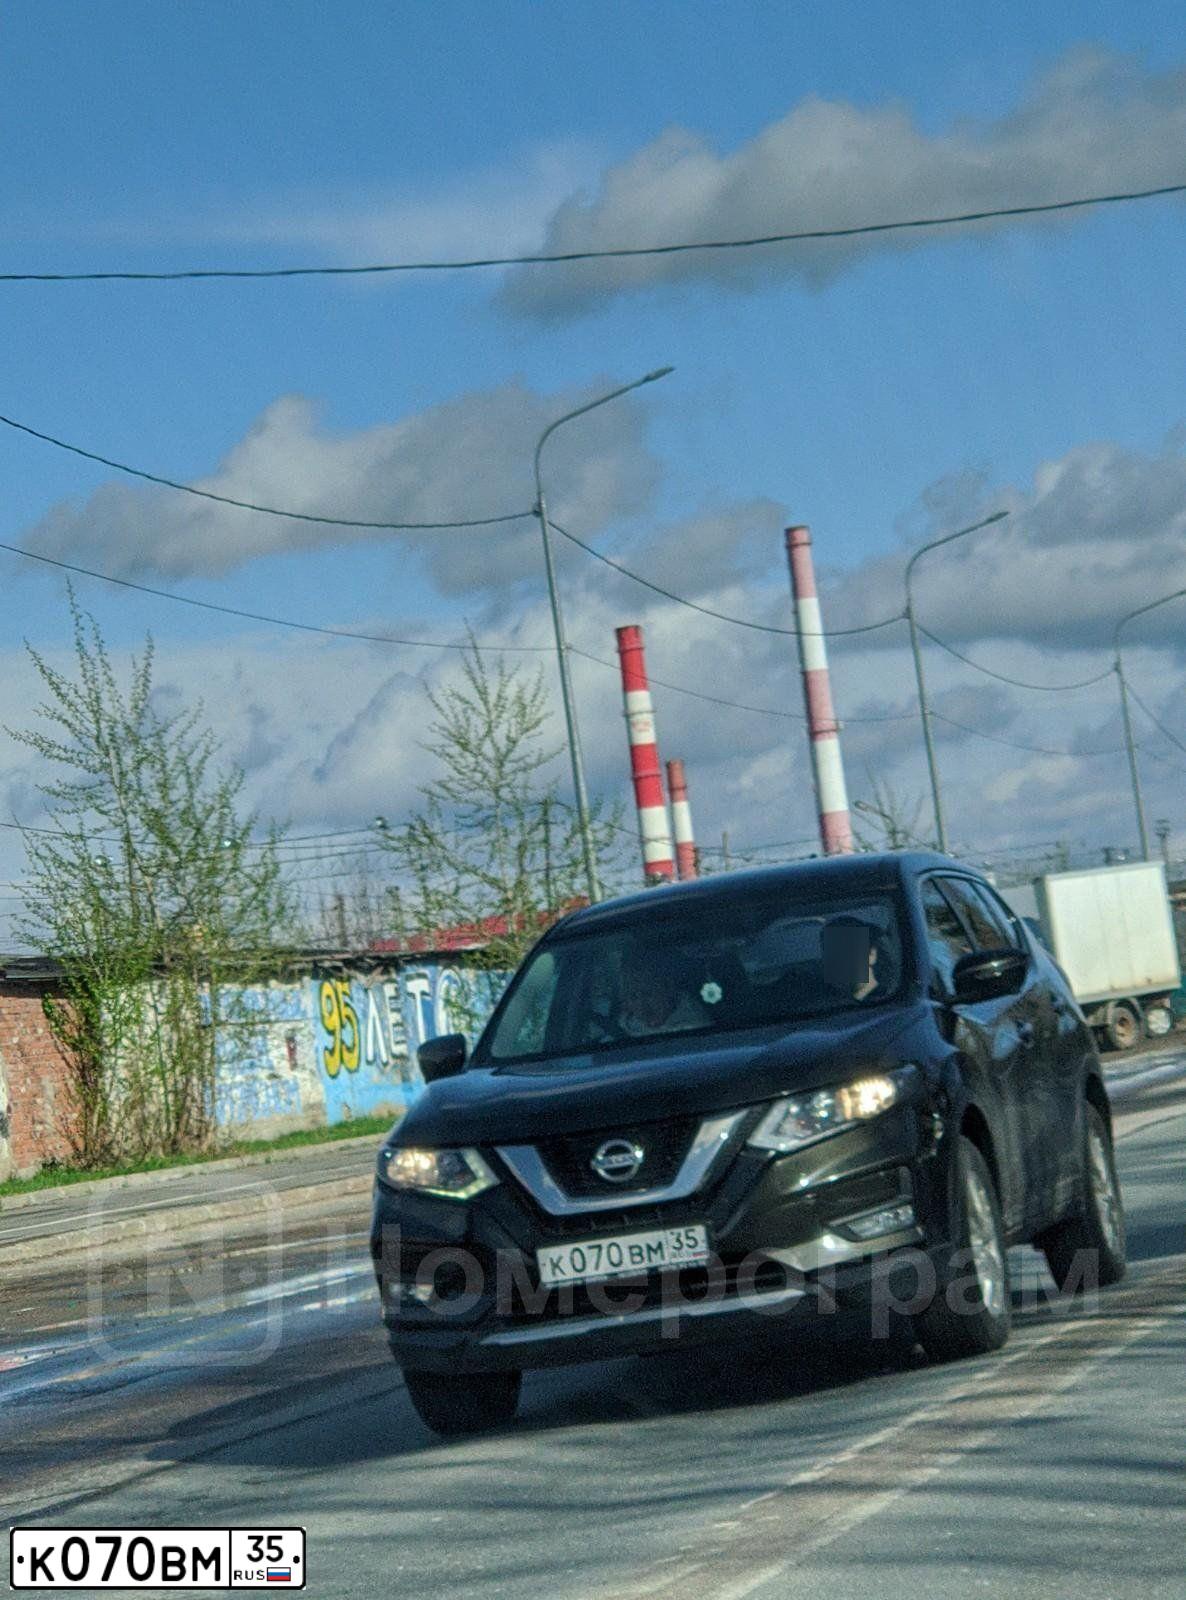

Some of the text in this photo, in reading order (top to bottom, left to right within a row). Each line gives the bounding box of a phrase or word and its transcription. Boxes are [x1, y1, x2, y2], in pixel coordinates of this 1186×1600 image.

[321, 979, 361, 1079] 95
[549, 1228, 699, 1277] К070ВМ 35
